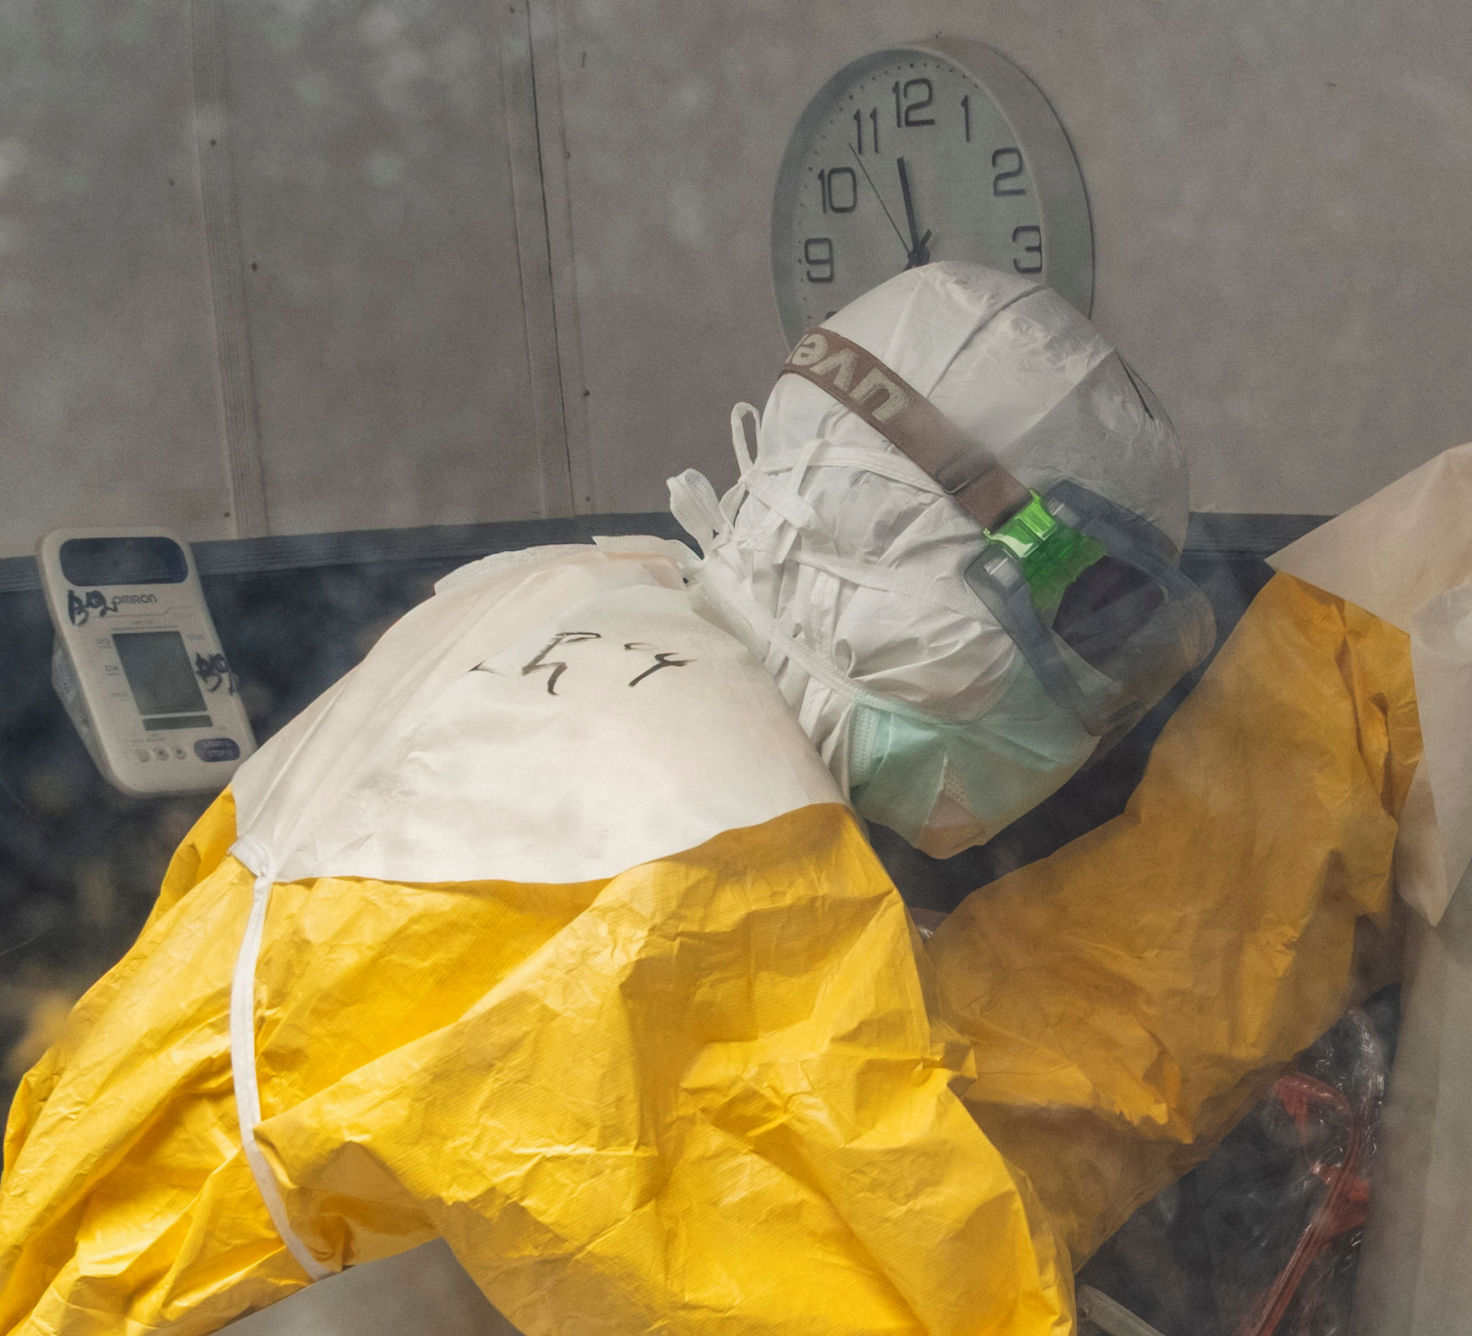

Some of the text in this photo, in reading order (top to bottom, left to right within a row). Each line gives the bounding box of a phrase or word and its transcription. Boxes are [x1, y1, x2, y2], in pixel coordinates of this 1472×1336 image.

[892, 78, 935, 128] 12
[961, 95, 971, 142] 1
[853, 108, 879, 155] 11
[818, 167, 858, 213] 10
[991, 147, 1027, 196] 2
[804, 237, 835, 283] 9
[1012, 225, 1043, 274] 3
[792, 333, 910, 423] uve
